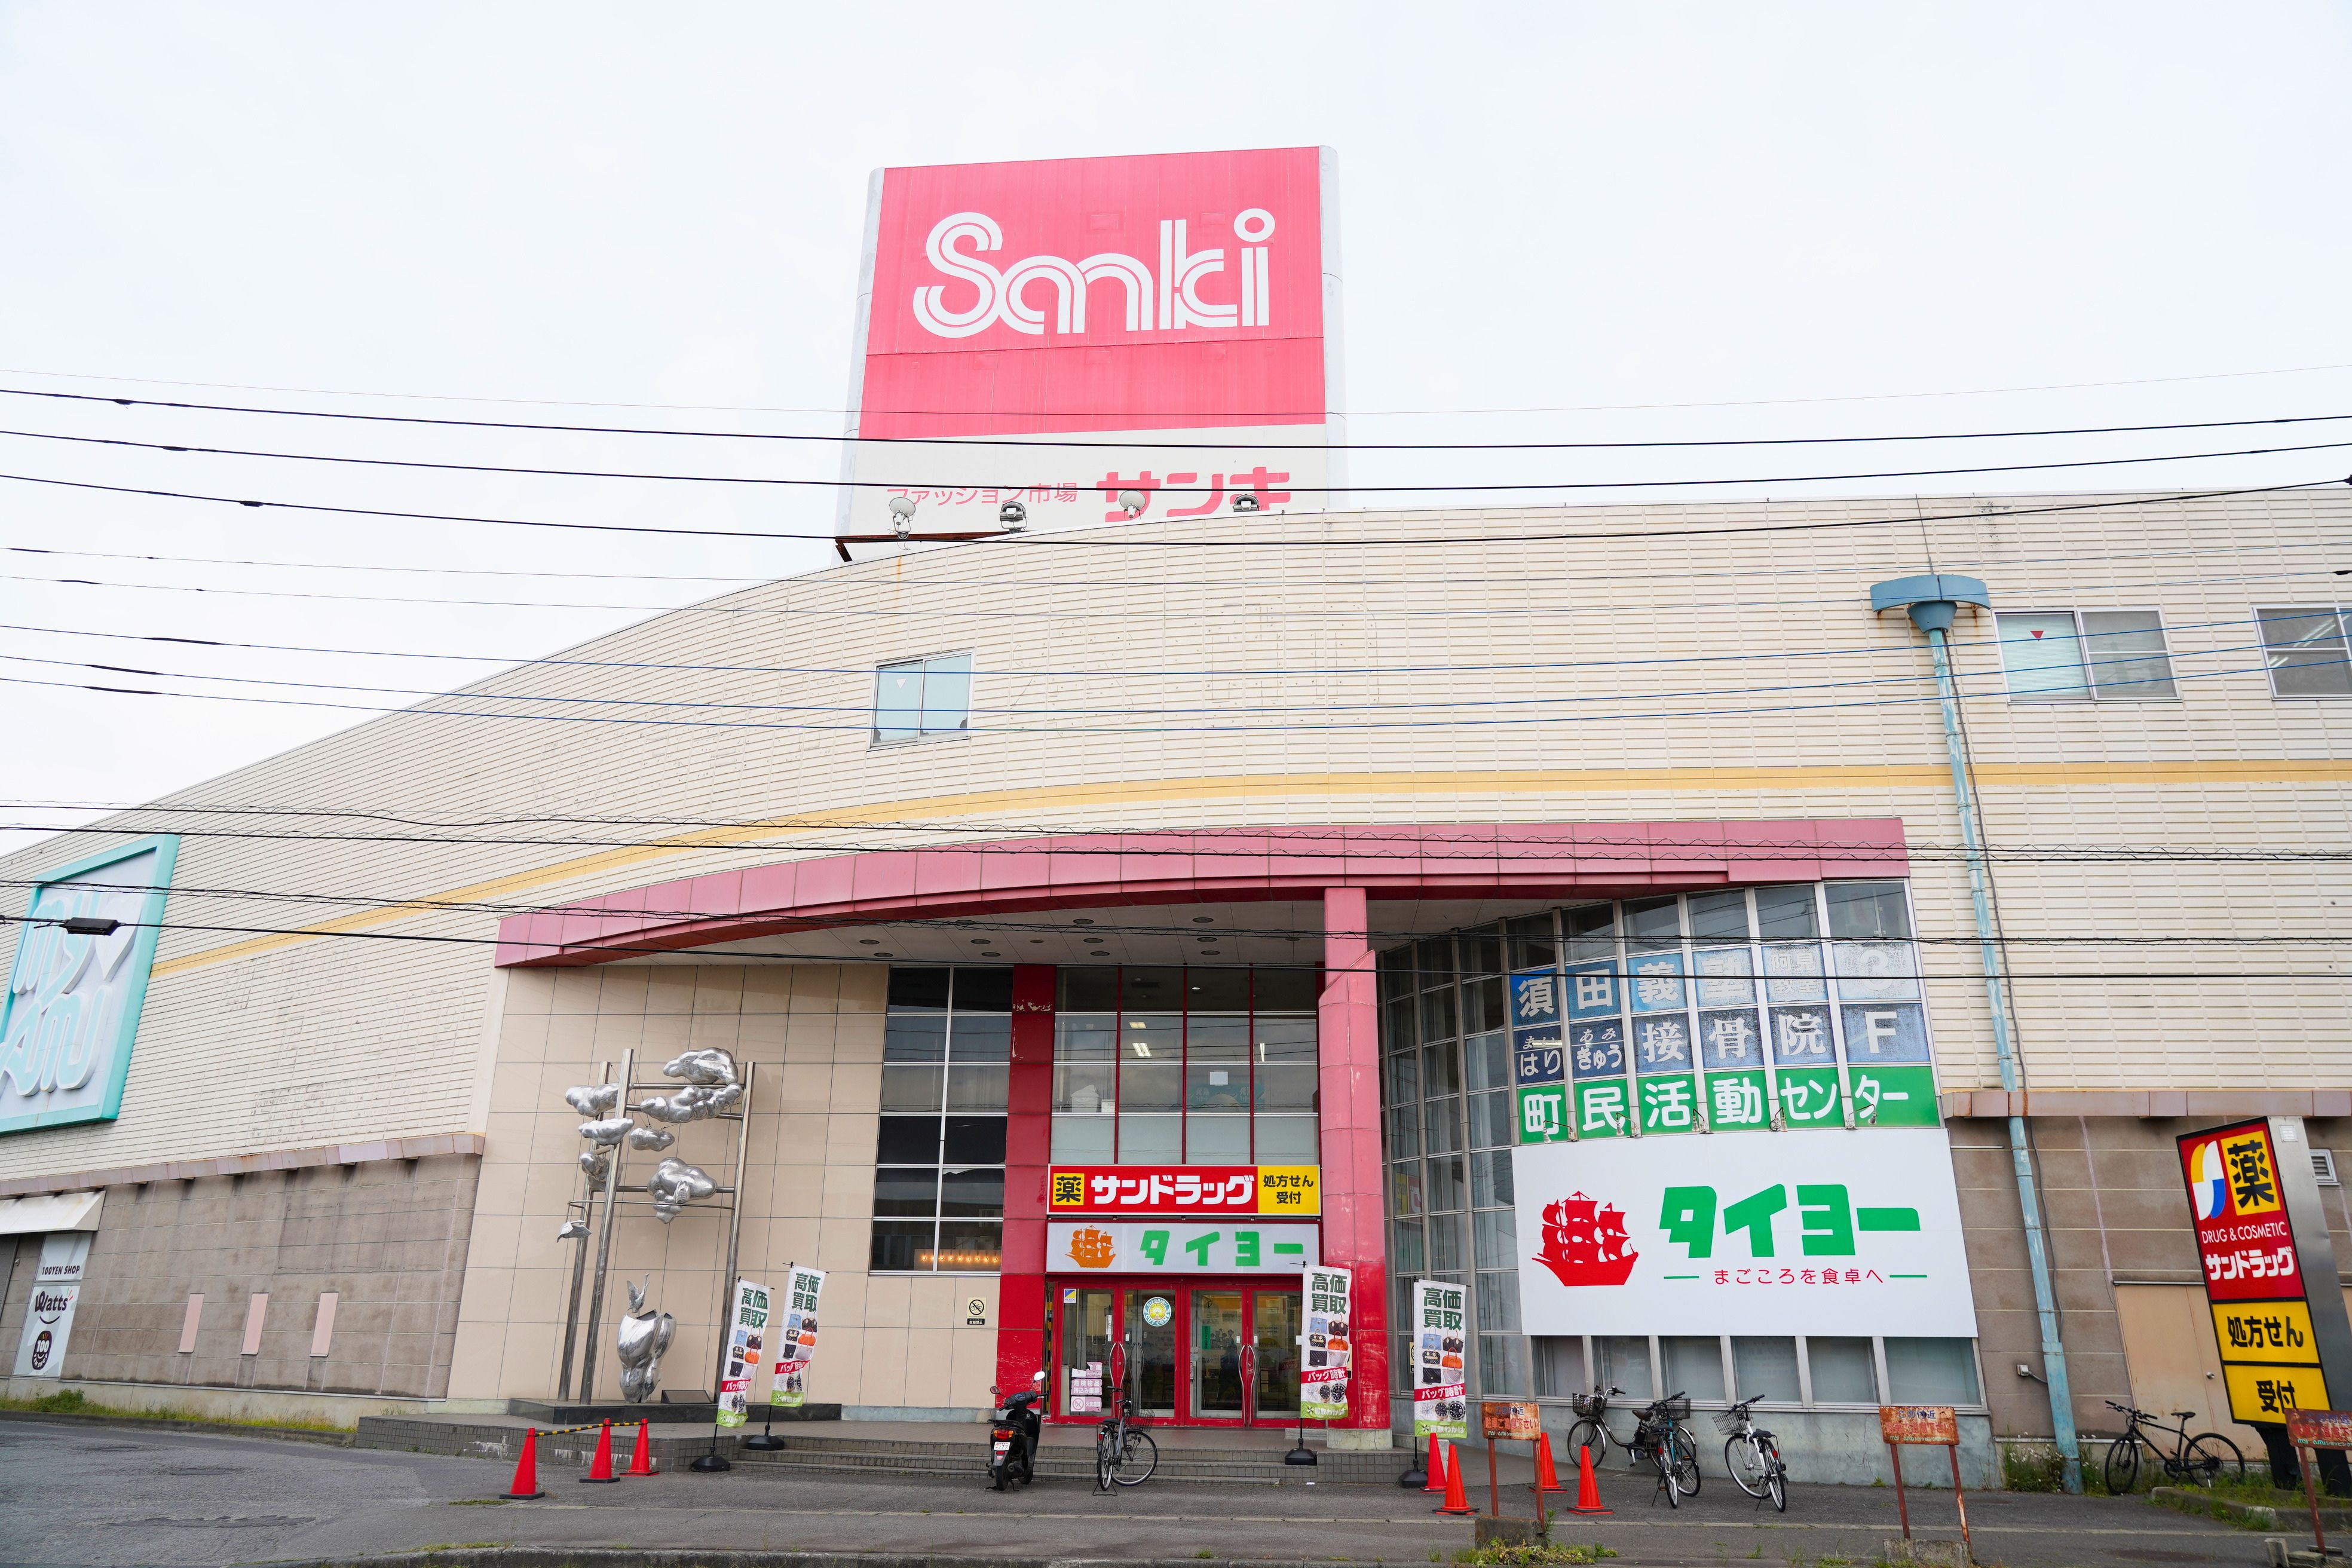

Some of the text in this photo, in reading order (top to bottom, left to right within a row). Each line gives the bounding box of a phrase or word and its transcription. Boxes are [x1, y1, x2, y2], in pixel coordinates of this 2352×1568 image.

[913, 208, 1275, 338] Sanki
[1097, 467, 1290, 522] サンキ
[1518, 956, 1747, 1017] 須田義塾
[1526, 1074, 1909, 1135] 町民活動センター
[2227, 1140, 2274, 1209] 薬
[1055, 1174, 1314, 1205] 薬 サンドラッグ 処方せん
[1276, 1191, 1301, 1204] 受付
[1659, 1184, 1921, 1258] タイヨー
[2201, 1221, 2287, 1244] DRUG & COSMETIC
[1140, 1230, 1303, 1266] タイヨー
[42, 1265, 80, 1275] 100YEN SHOP
[2206, 1246, 2295, 1280] サンドラッグ
[794, 1273, 821, 1294] 高価
[1312, 1272, 1348, 1294] 高価
[1714, 1267, 1884, 1285] まごころを食卓へ
[35, 1291, 68, 1312] Watts
[742, 1288, 768, 1310] 高価
[792, 1292, 817, 1312] 買取
[1311, 1293, 1347, 1315] 買取
[1423, 1287, 1462, 1310] 高価
[739, 1307, 768, 1328] 買取
[1423, 1309, 1462, 1331] 買取
[2227, 1316, 2304, 1348] 処方せん
[37, 1340, 50, 1353] 100
[1307, 1368, 1346, 1381] バッグ時計
[1422, 1385, 1463, 1399] バッグ時計
[2256, 1380, 2296, 1414] 受付
